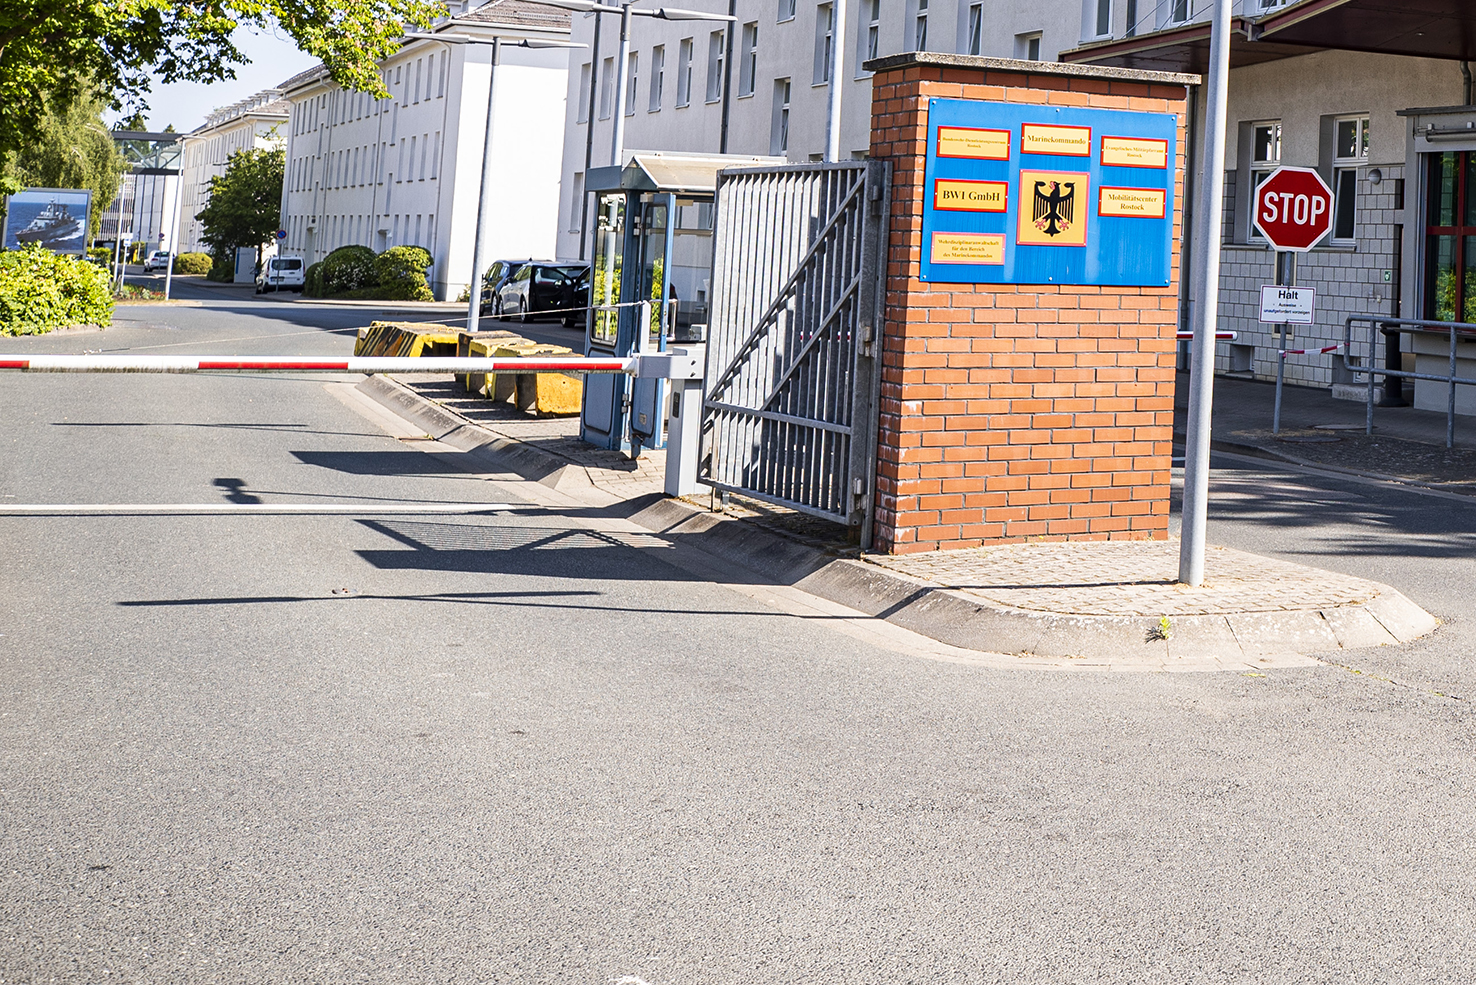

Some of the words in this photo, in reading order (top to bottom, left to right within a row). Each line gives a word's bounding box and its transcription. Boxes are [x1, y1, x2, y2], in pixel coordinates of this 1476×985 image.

[1027, 135, 1086, 145] Marinekommando
[943, 190, 965, 200] BWI
[968, 191, 1000, 201] GmbH
[1108, 194, 1157, 202] Mobilitätscenter
[1263, 191, 1326, 226] STOP
[1278, 290, 1298, 300] Halt
